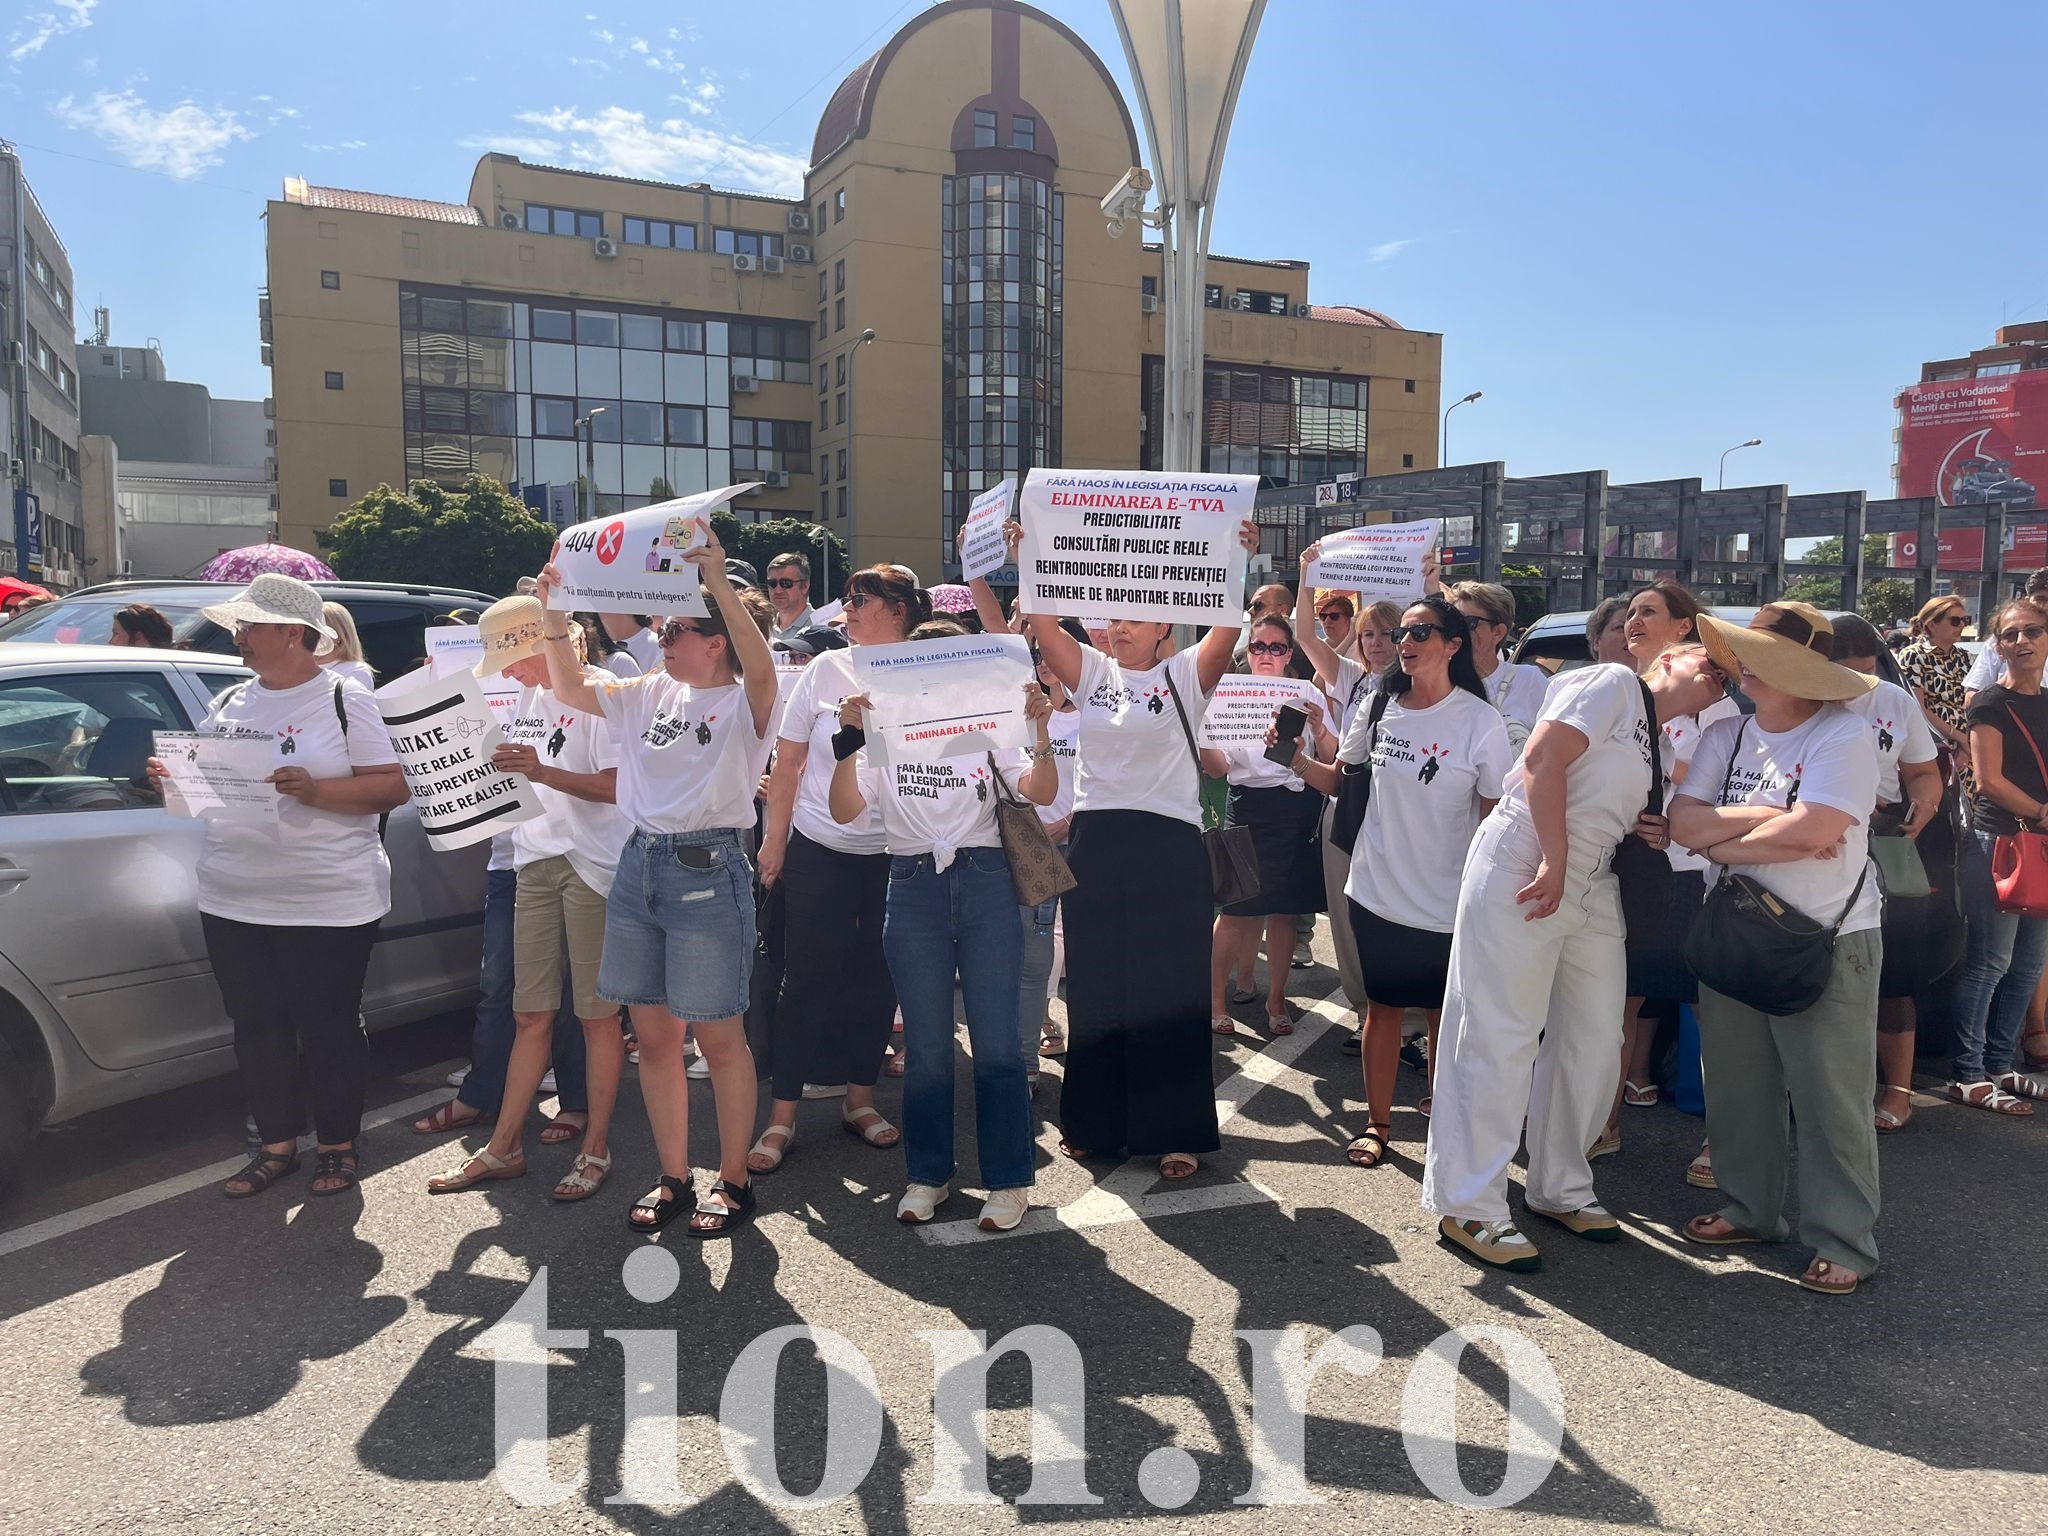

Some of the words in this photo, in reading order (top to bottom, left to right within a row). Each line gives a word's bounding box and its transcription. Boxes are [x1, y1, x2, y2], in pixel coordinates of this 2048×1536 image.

[1947, 390, 1958, 398] cu
[1960, 383, 2008, 397] Vodafone!
[1911, 402, 1938, 414] Meriți
[1940, 400, 1957, 410] ce-i
[1958, 398, 1977, 409] mai
[1977, 397, 1999, 406] bun.
[1077, 479, 1109, 488] HAOS
[1111, 478, 1125, 489] ÎN
[1126, 481, 1188, 493] LEGISLAȚIA
[1190, 482, 1238, 493] FISCALĂ
[1340, 483, 1351, 498] 18
[1050, 492, 1163, 510] ELIMINAREA
[1167, 497, 1225, 513] E-TVA
[1083, 512, 1182, 530] PREDICTIBILITATE
[565, 531, 598, 553] 404
[1053, 534, 1121, 553] CONSULTĂRI
[1123, 538, 1170, 555] PUBLICE
[1173, 541, 1209, 556] REALE
[1366, 554, 1389, 562] PUBLICE
[1035, 559, 1128, 579] REINTRODUCEREA
[1131, 564, 1158, 580] LEGII
[1162, 565, 1227, 587] PREVENȚIEI
[1320, 562, 1367, 572] REINTRODUCEREA
[1368, 565, 1382, 573] LEGII
[1320, 572, 1344, 581] TERMENE
[1352, 575, 1384, 584] RAPORTARE
[1385, 577, 1411, 586] REALISTE
[577, 588, 615, 599] mulțumim
[616, 589, 643, 600] pentru
[1036, 583, 1086, 601] TERMENE
[1089, 586, 1102, 601] DE
[1106, 588, 1169, 605] RAPORTARE
[1173, 592, 1224, 608] REALISTE
[451, 638, 468, 646] HAOS
[468, 637, 477, 645] ÎN
[893, 656, 915, 665] HAOS
[916, 653, 926, 662] ÎN
[926, 650, 970, 662] LEGISLAȚIA
[1269, 690, 1300, 698] E-TVA
[1227, 702, 1274, 710] PREDICTIBILITATE
[905, 725, 966, 742] ELIMINAREA
[967, 721, 997, 733] E-TVA
[1205, 723, 1251, 731] REINTRODUCEREA
[1052, 739, 1068, 747] AOS
[1385, 735, 1411, 748] HAOS
[433, 747, 475, 771] REALE
[926, 765, 953, 776] HAOS
[897, 773, 908, 784] ÎN
[911, 775, 967, 790] LEGISLAȚIA
[412, 781, 435, 798] LEGII
[459, 777, 518, 809] REALISTE
[898, 786, 939, 800] FISCALĂ
